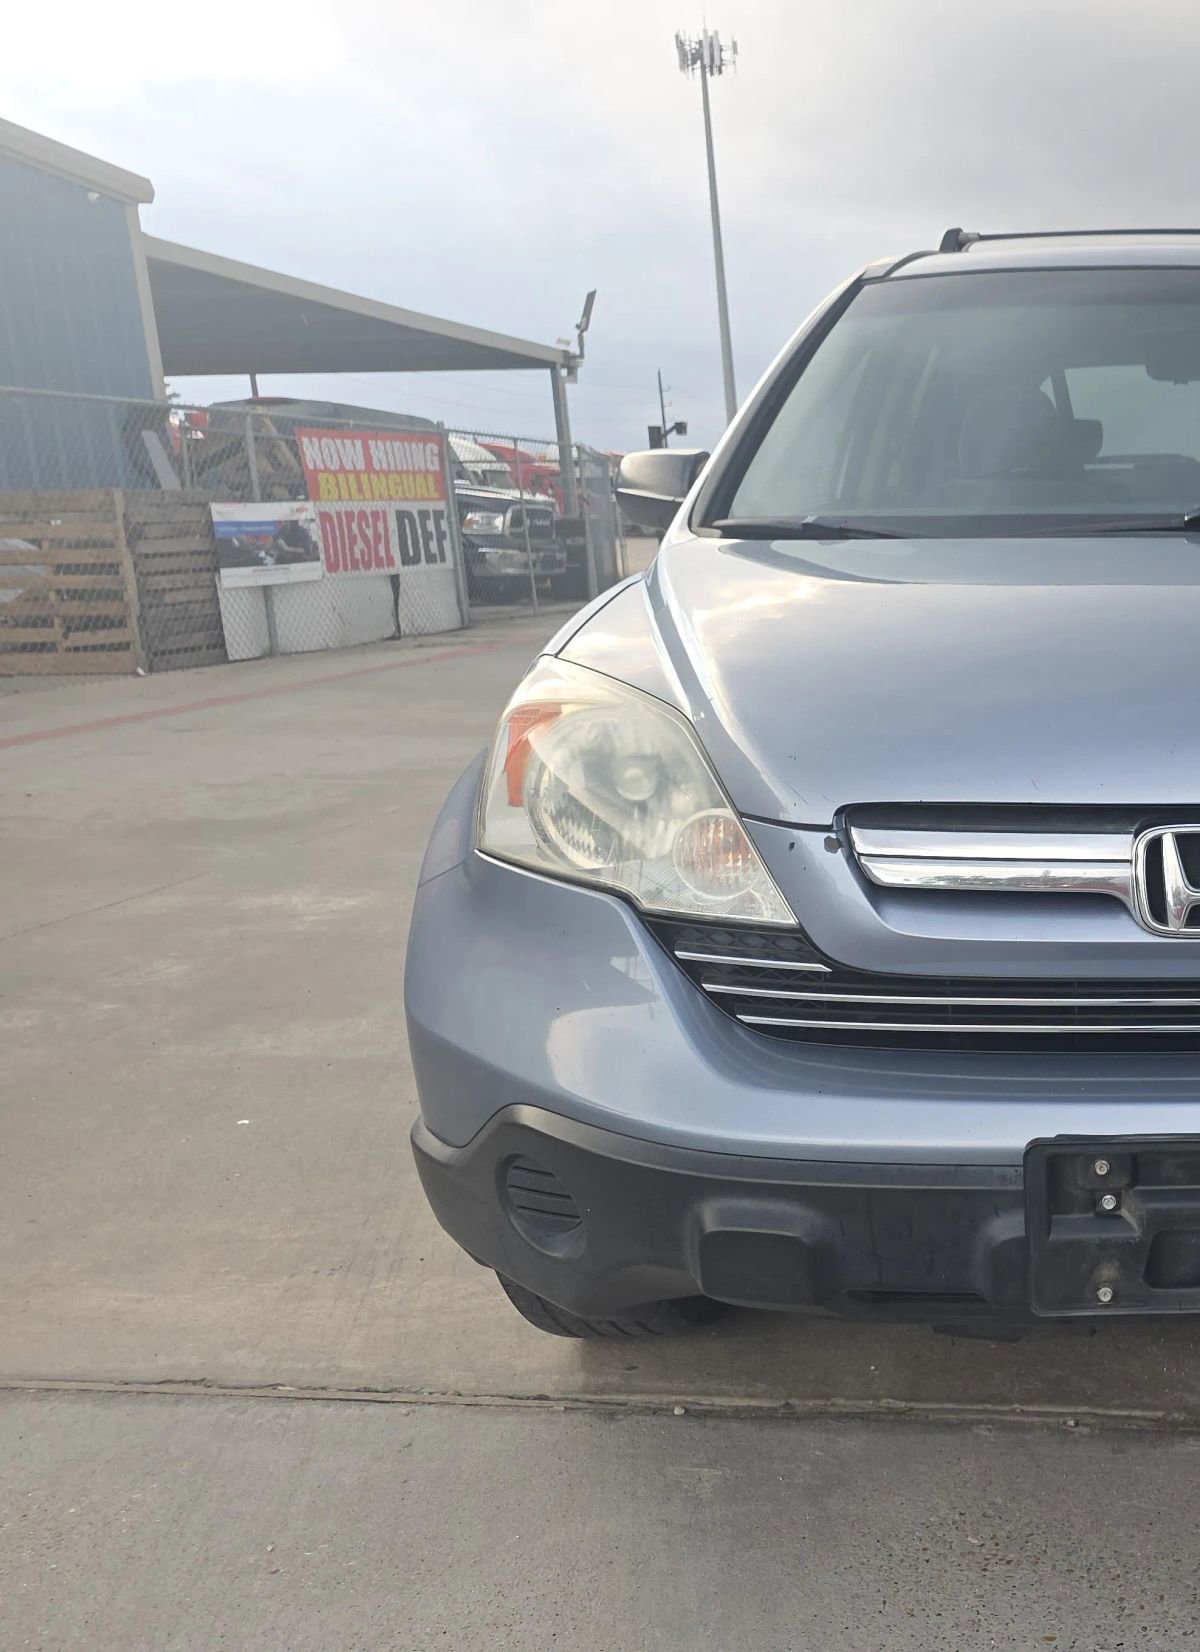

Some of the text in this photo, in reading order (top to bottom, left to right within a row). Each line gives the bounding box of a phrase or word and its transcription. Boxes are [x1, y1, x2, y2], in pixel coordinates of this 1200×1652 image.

[301, 436, 440, 472] NOW HIRING
[318, 472, 440, 500] BILINGUAL
[318, 509, 447, 574] DIESEL DEF
